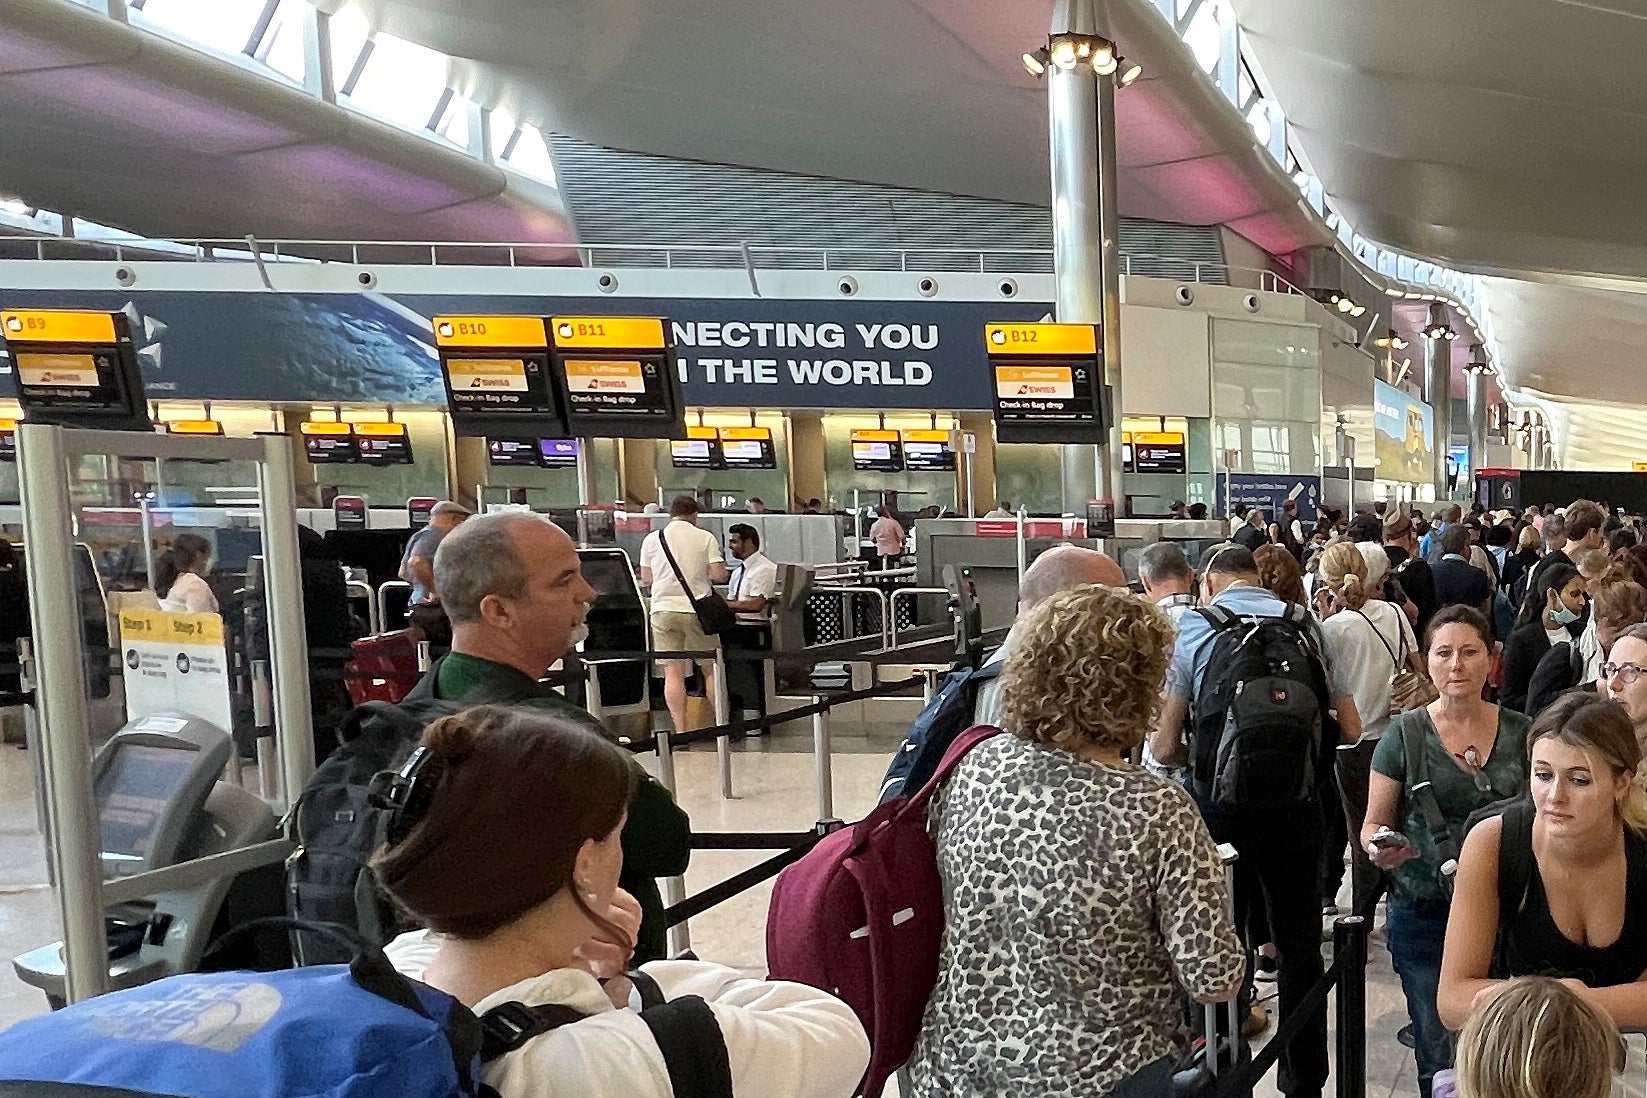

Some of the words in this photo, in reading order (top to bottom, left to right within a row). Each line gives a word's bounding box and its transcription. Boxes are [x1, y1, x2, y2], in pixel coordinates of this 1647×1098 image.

[26, 317, 46, 330] B9
[459, 323, 487, 336] B10
[578, 324, 606, 337] B11
[671, 321, 846, 349] NECTING
[855, 324, 939, 350] YOU
[1011, 330, 1038, 342] B12
[697, 358, 779, 385] THE
[787, 359, 933, 386] WORLD
